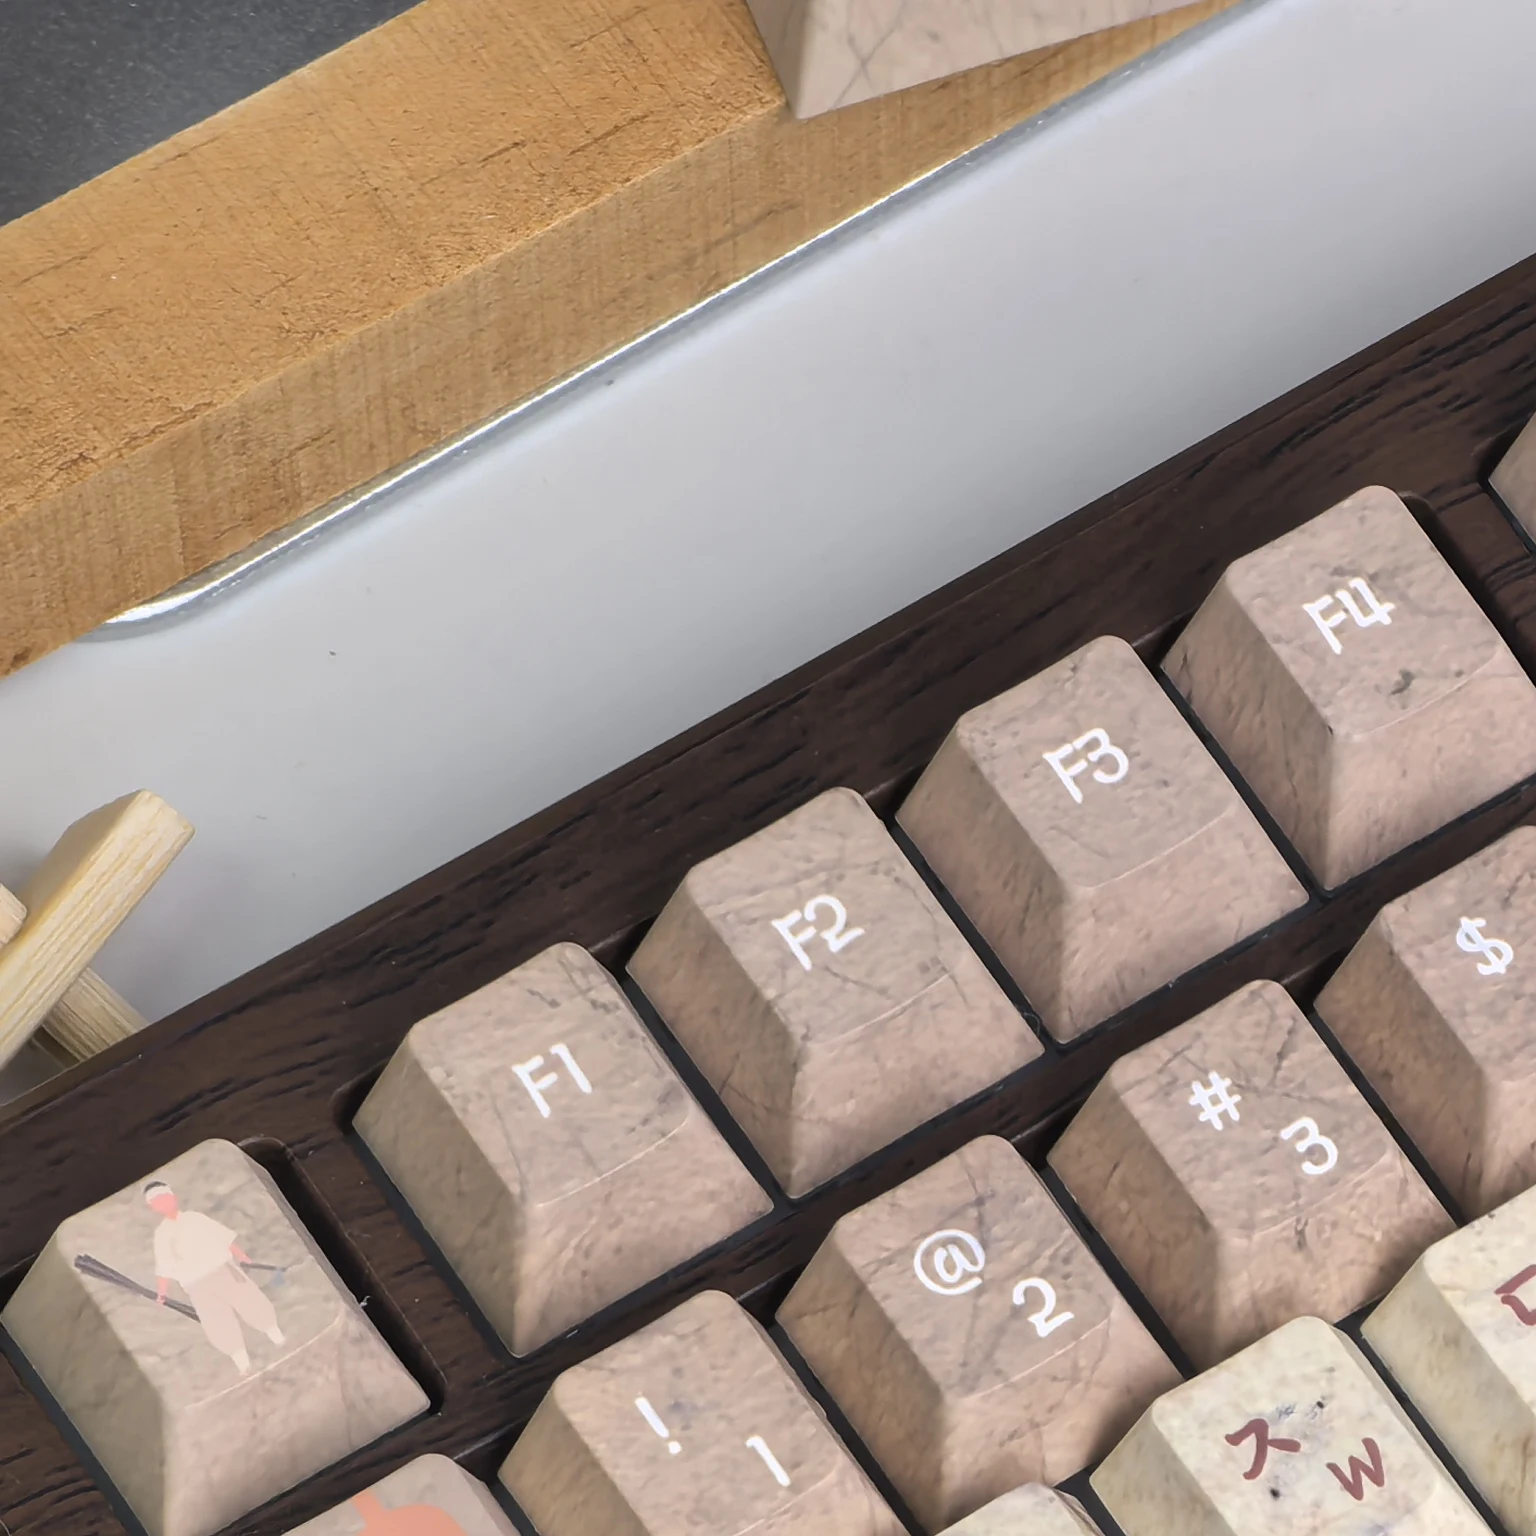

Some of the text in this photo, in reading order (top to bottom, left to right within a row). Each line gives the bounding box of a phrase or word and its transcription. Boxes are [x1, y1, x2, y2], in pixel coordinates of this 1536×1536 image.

[1303, 579, 1394, 655] F4
[1042, 729, 1129, 804] F3
[771, 896, 864, 971] F2
[1455, 918, 1514, 976] $
[511, 1045, 593, 1119] F1
[1188, 1071, 1242, 1131] #
[1279, 1118, 1339, 1176] 3
[913, 1230, 986, 1296] @
[1012, 1278, 1075, 1338] 2
[745, 1437, 790, 1486] 1
[1329, 1437, 1385, 1501] W
